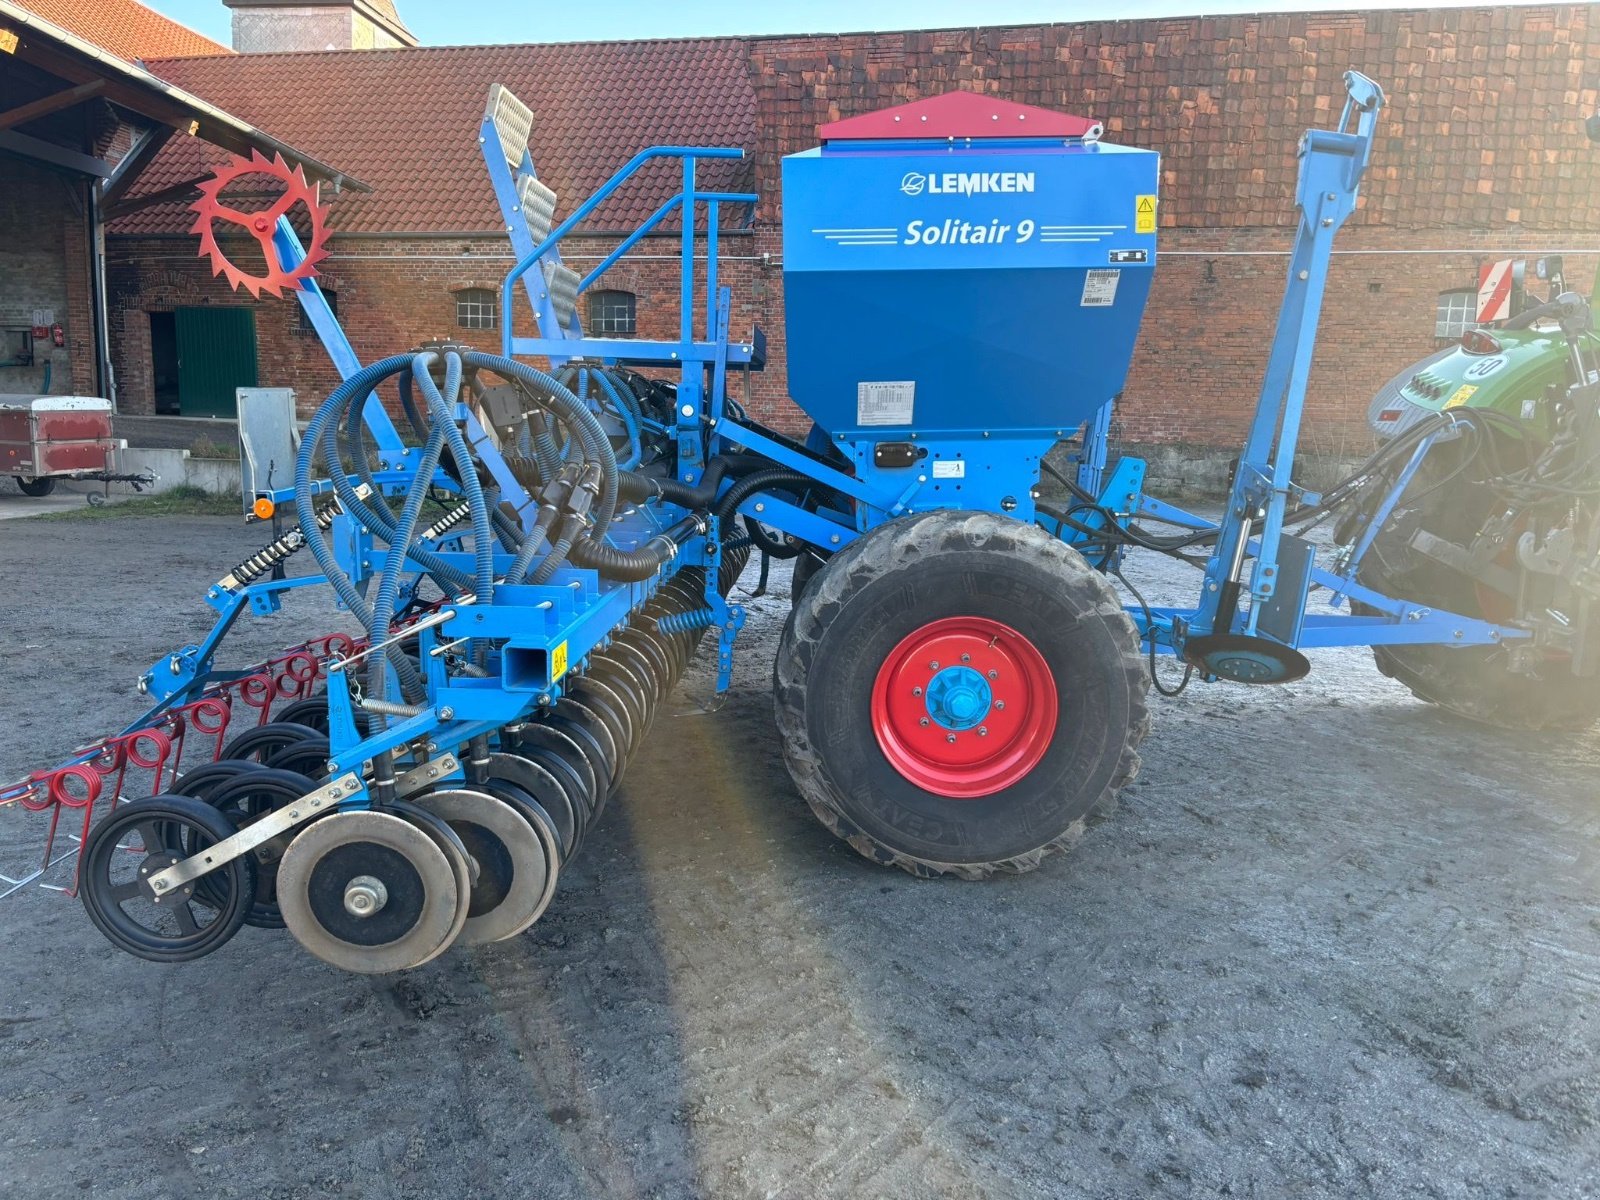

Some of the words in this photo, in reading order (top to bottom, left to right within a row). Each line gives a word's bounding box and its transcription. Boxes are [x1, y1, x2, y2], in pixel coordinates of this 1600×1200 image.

[928, 172, 1035, 198] LEMKEN
[903, 218, 1011, 245] Solitair
[1015, 219, 1035, 243] 9
[1468, 358, 1503, 376] 50
